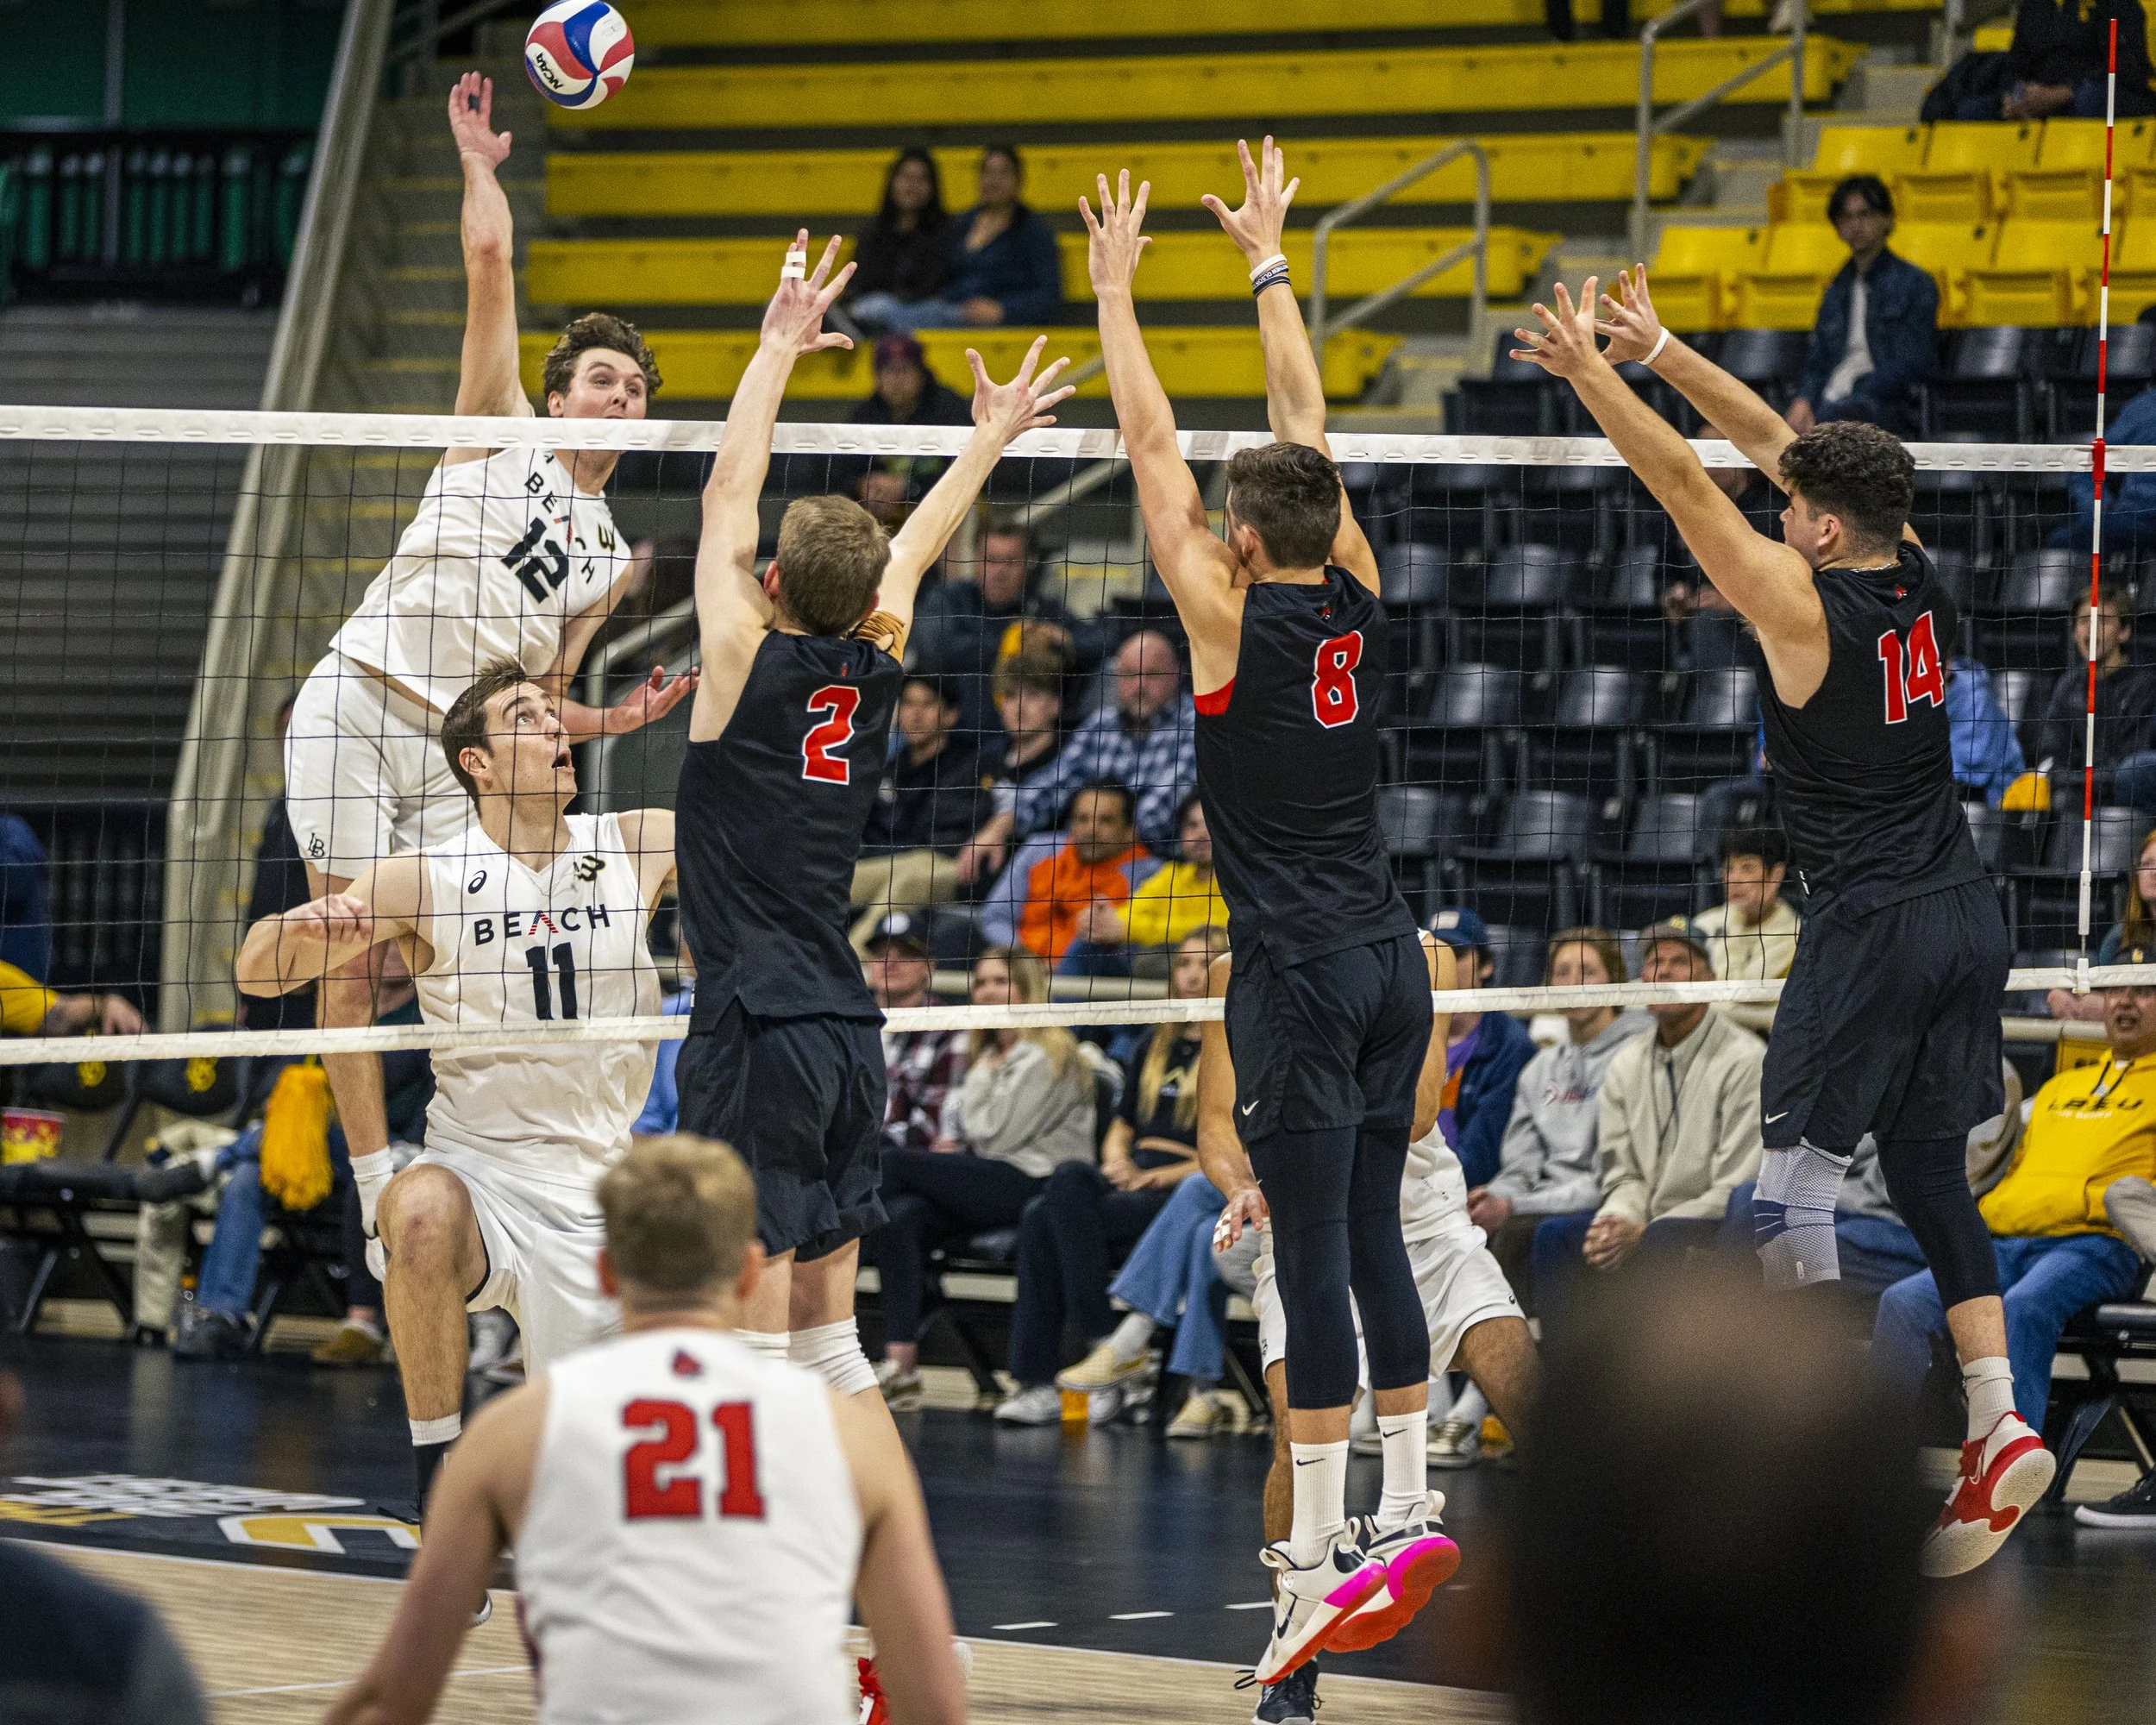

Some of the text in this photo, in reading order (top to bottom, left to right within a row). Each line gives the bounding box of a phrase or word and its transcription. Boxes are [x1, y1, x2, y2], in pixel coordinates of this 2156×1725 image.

[536, 53, 563, 90] NCAA
[500, 517, 570, 605] 12
[1311, 630, 1364, 730] 8
[1877, 609, 1945, 724] 14
[801, 684, 862, 786] 2
[473, 903, 611, 946] BEACH
[524, 941, 579, 1021] 11
[621, 1396, 766, 1521] 21
